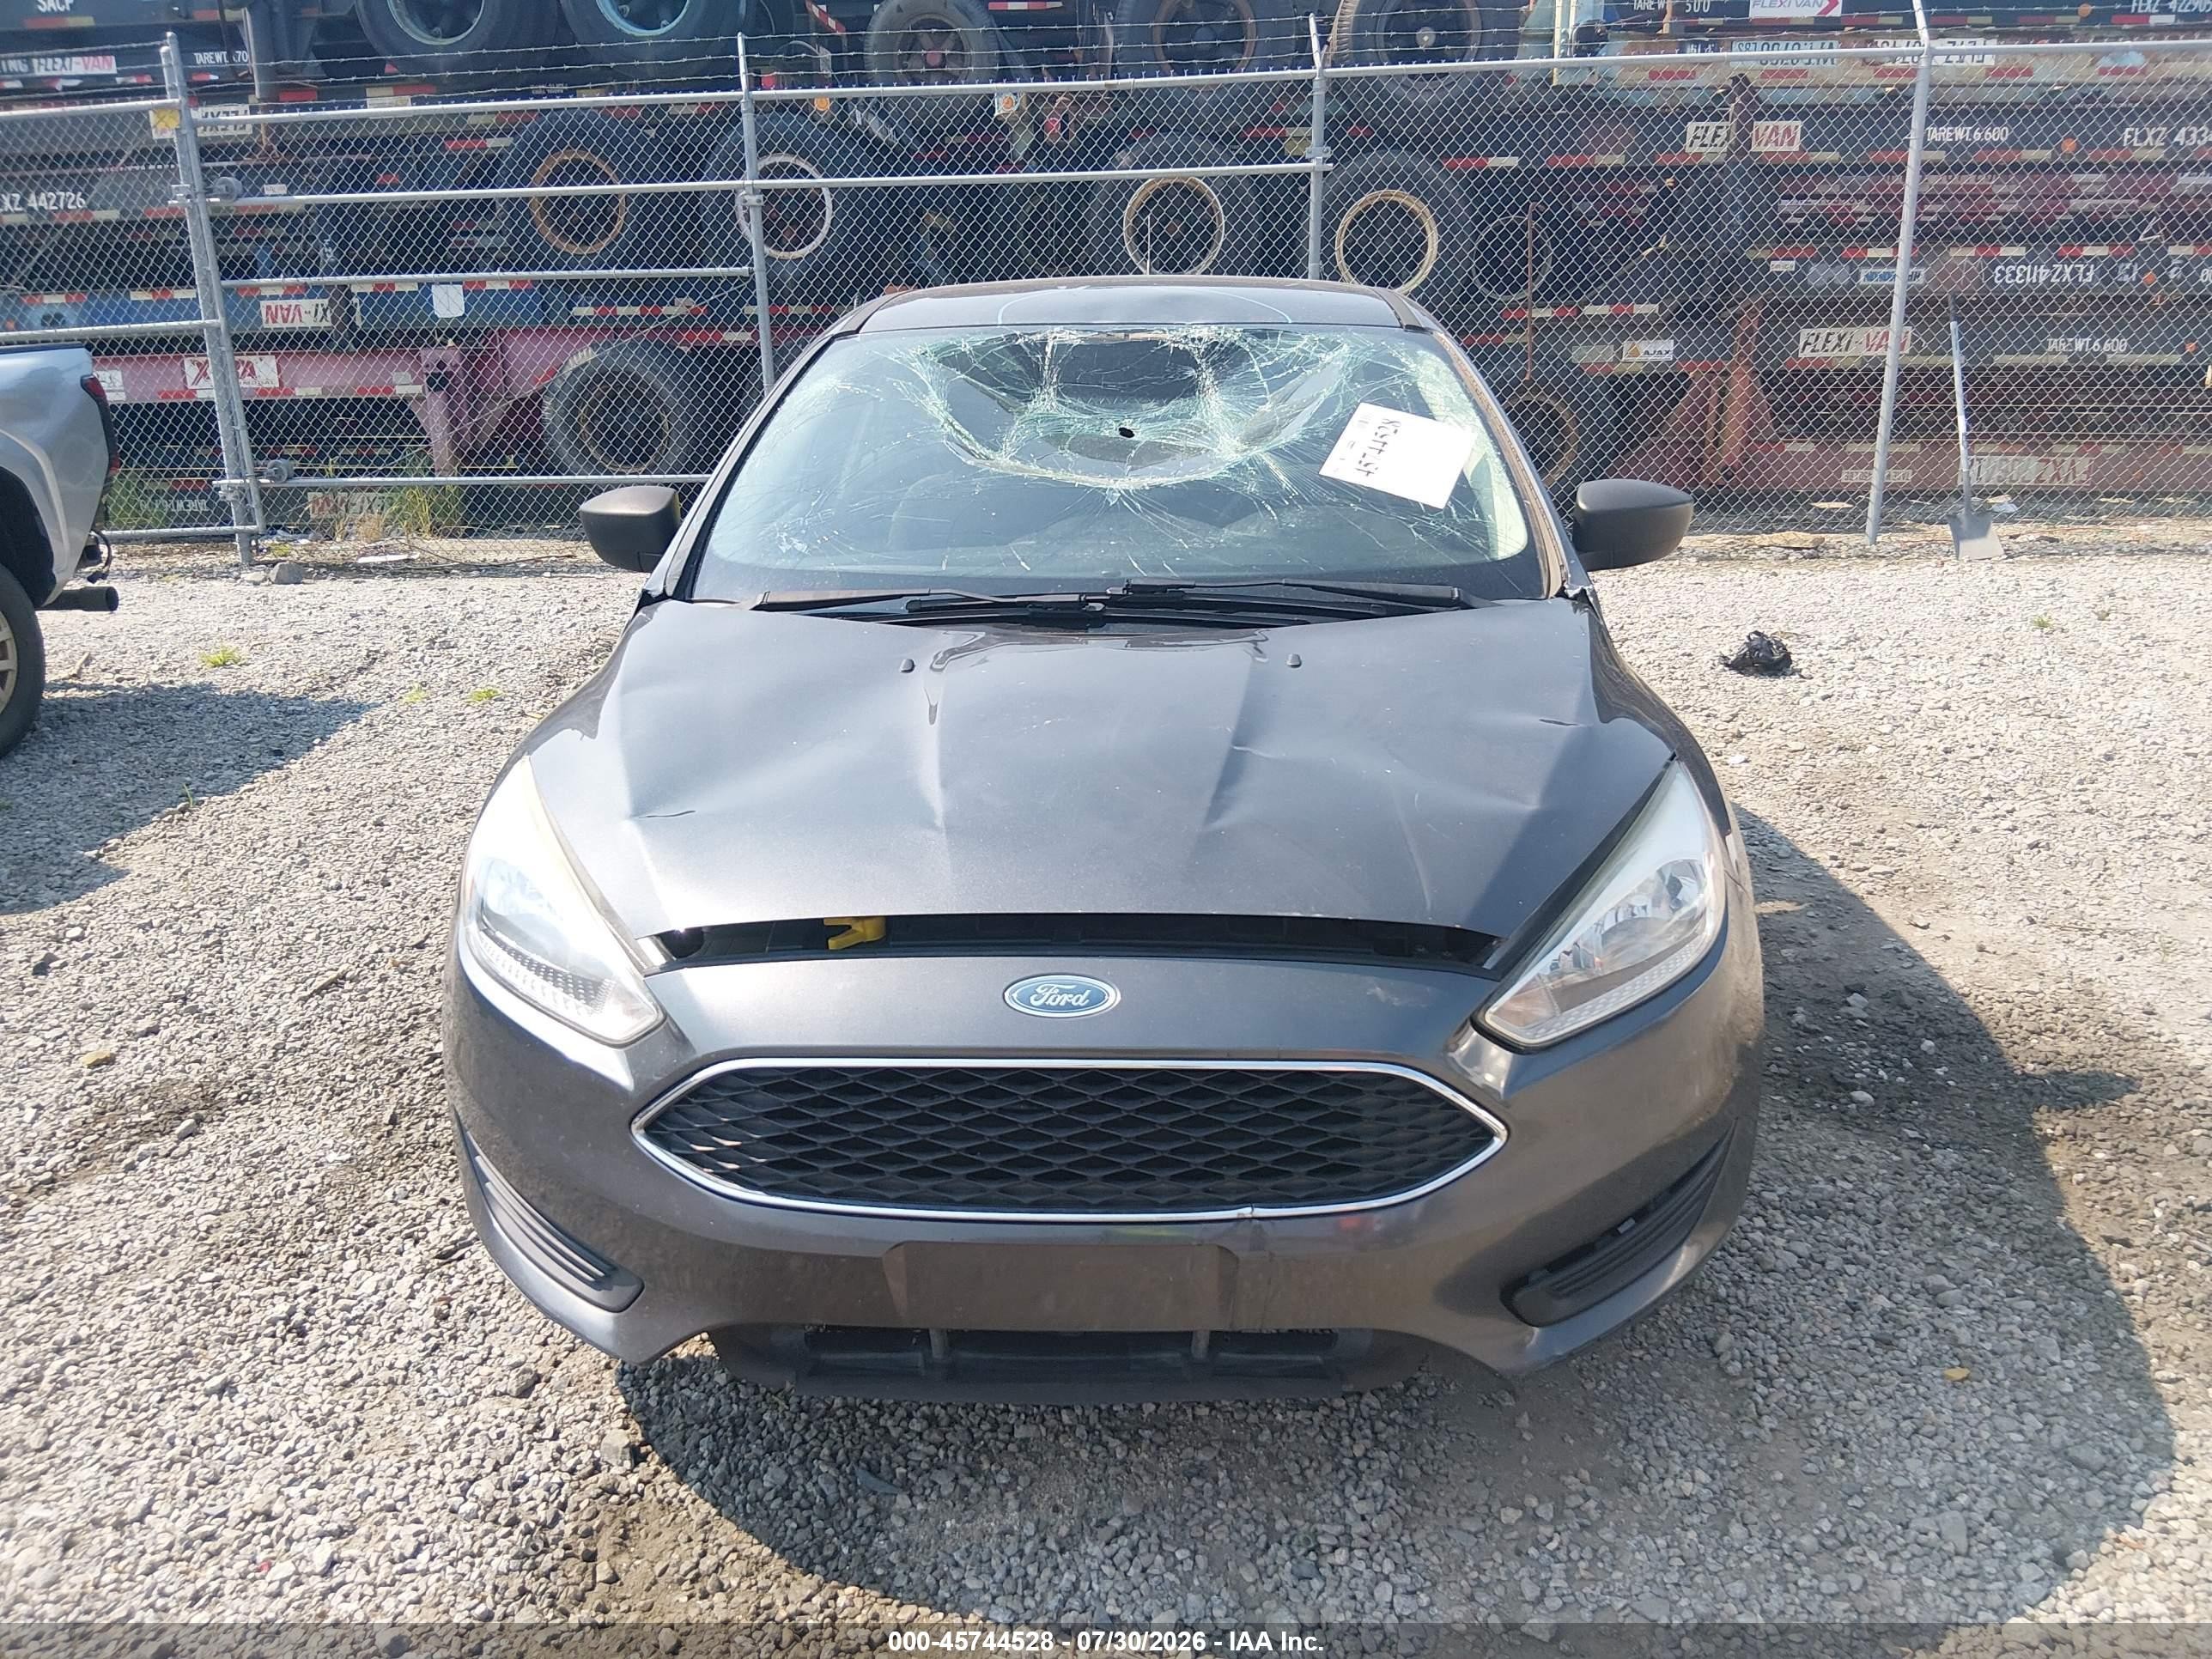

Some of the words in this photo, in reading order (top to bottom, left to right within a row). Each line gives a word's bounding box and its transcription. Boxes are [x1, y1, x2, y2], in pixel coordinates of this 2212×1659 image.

[2123, 126, 2167, 147] FLXZ
[0, 192, 23, 211] XZ
[27, 191, 87, 210] 442726
[1030, 983, 1091, 1006] Ford
